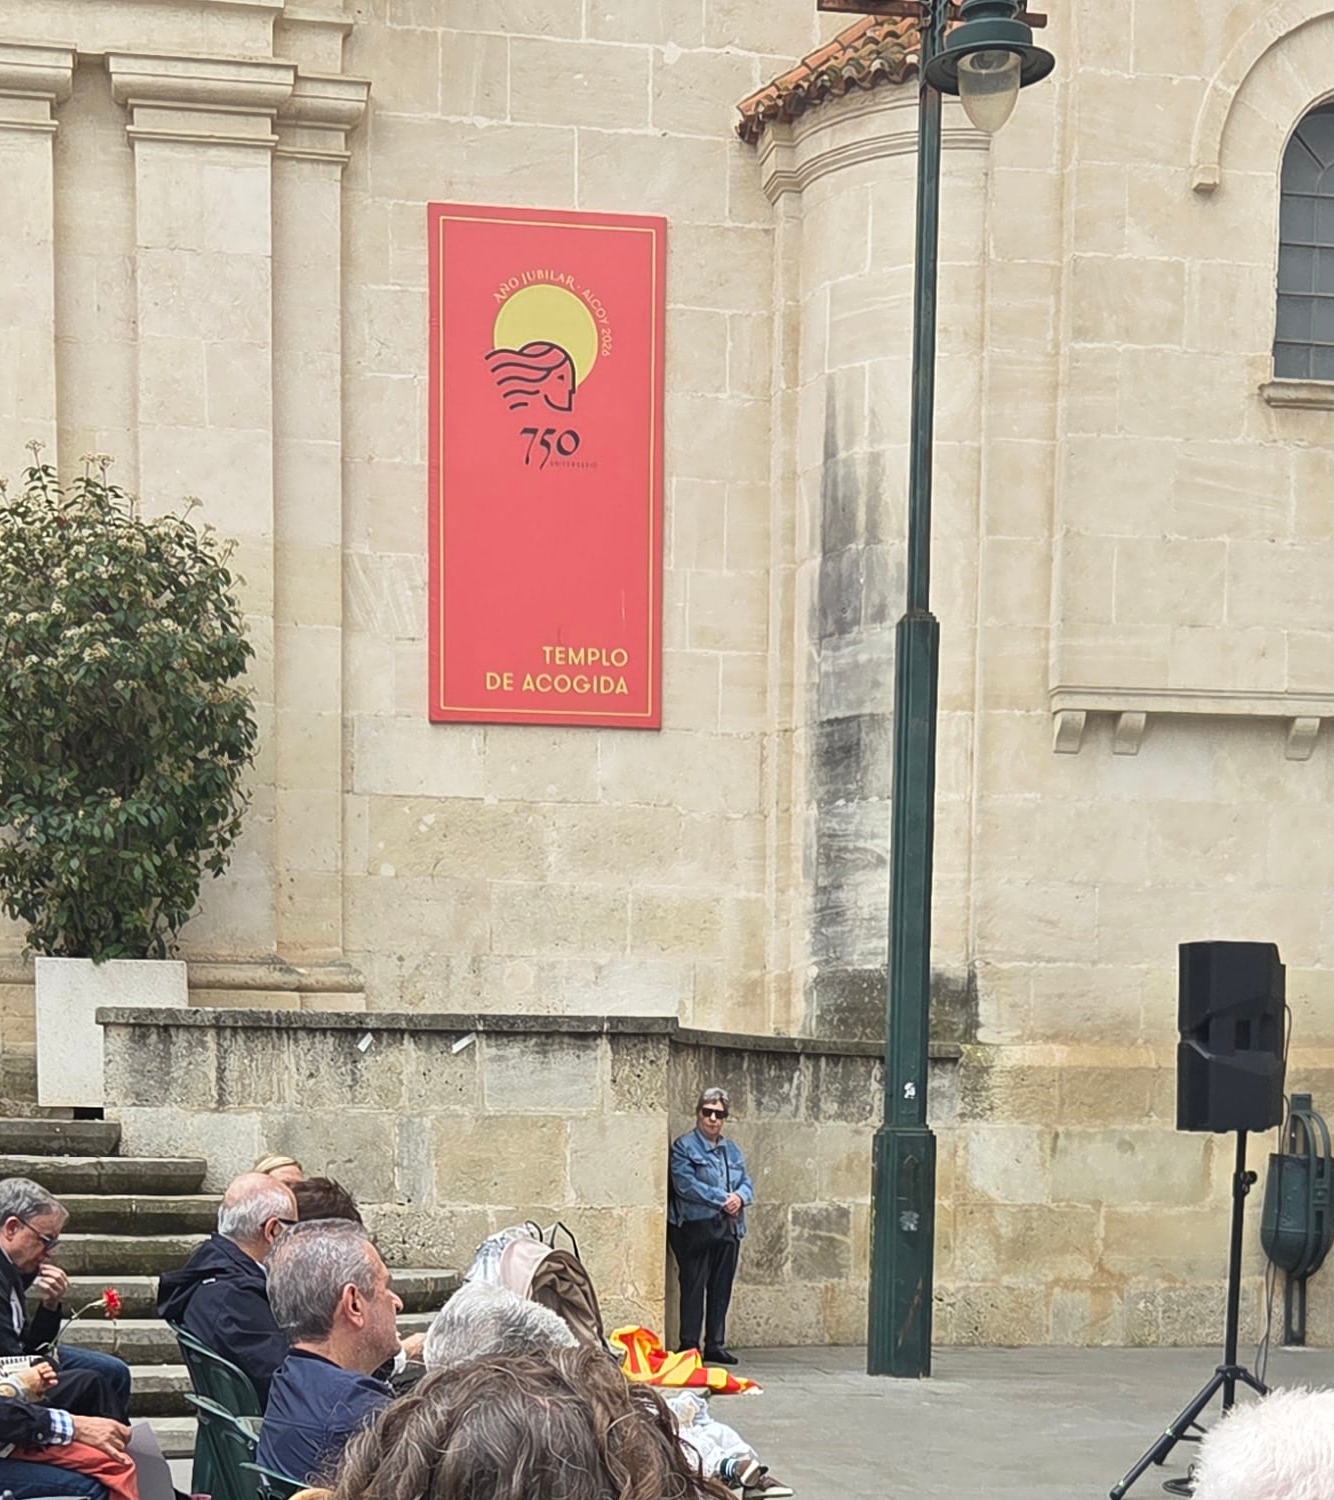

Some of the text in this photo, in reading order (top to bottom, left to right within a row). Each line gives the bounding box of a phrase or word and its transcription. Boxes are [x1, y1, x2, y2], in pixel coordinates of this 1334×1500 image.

[493, 269, 612, 357] AÑO JUBILAR ALCOY 2026
[520, 427, 580, 470] 750
[542, 646, 628, 667] TEMPLO
[486, 672, 628, 694] DE ACOGIDA
